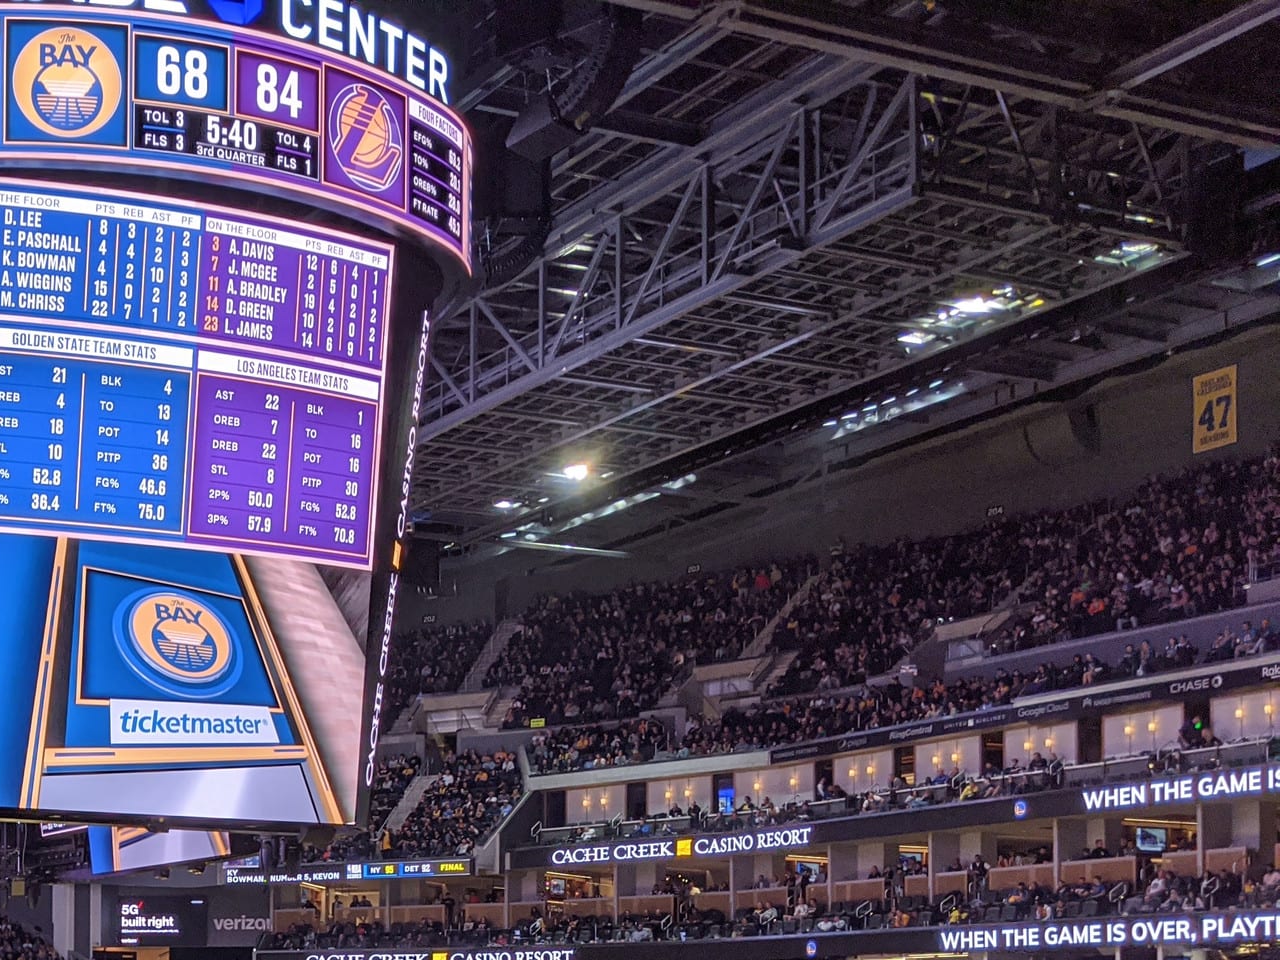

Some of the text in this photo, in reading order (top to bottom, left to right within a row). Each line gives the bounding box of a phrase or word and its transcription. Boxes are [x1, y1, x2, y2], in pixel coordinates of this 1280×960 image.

[39, 43, 98, 68] BAY
[282, 0, 449, 104] CENTER
[157, 45, 208, 100] 68
[257, 63, 303, 119] 84
[145, 109, 184, 126] TOL 3
[145, 133, 184, 150] FLS 3
[207, 116, 257, 150] 5:40
[276, 132, 311, 152] TOL 4
[197, 144, 265, 166] 3rd QUARTER
[276, 155, 311, 175] FLS 1
[0, 193, 20, 204] THE
[23, 195, 60, 208] FLOOR
[4, 209, 42, 228] D. LEE
[3, 229, 82, 253] E. PASCHALL
[208, 220, 277, 241] ON THE FLOOR
[229, 239, 275, 261] A. DAVIS
[2, 250, 76, 273] K. BOWMAN
[228, 259, 277, 282] J. MCGEE
[1, 271, 72, 293] A. WIGGINS
[227, 279, 288, 304] A. BRADLEY
[0, 291, 65, 312] M. CHRISS
[225, 299, 274, 321] D. GREEN
[224, 319, 273, 341] L. JAMES
[12, 332, 157, 360] GOLDEN STATE TEAM STATS
[237, 359, 349, 391] LOS ANGELES TEAM STATS
[1199, 395, 1231, 432] 47
[365, 311, 431, 788] CACHE CREEK CASINO RESORT
[155, 603, 203, 626] BAY
[1170, 679, 1210, 694] CHASE
[120, 709, 263, 736] ticketmaster
[1083, 786, 1146, 811] WHEN
[1150, 779, 1192, 801] THE
[1198, 771, 1261, 796] GAME
[552, 828, 812, 864] CACHE CREEK CASINO RESORT
[227, 869, 238, 877] KY
[270, 874, 302, 882] NUMR
[313, 872, 340, 880] KEVON
[370, 867, 381, 875] NY
[404, 865, 419, 873] DET
[440, 862, 465, 872] FINAL
[121, 905, 139, 916] 5G
[121, 915, 174, 929] built right
[941, 931, 997, 950] WHEN
[1001, 928, 1040, 947] THE
[1044, 924, 1101, 945] GAME
[1107, 923, 1126, 942] IS
[1131, 919, 1196, 943] OVER,
